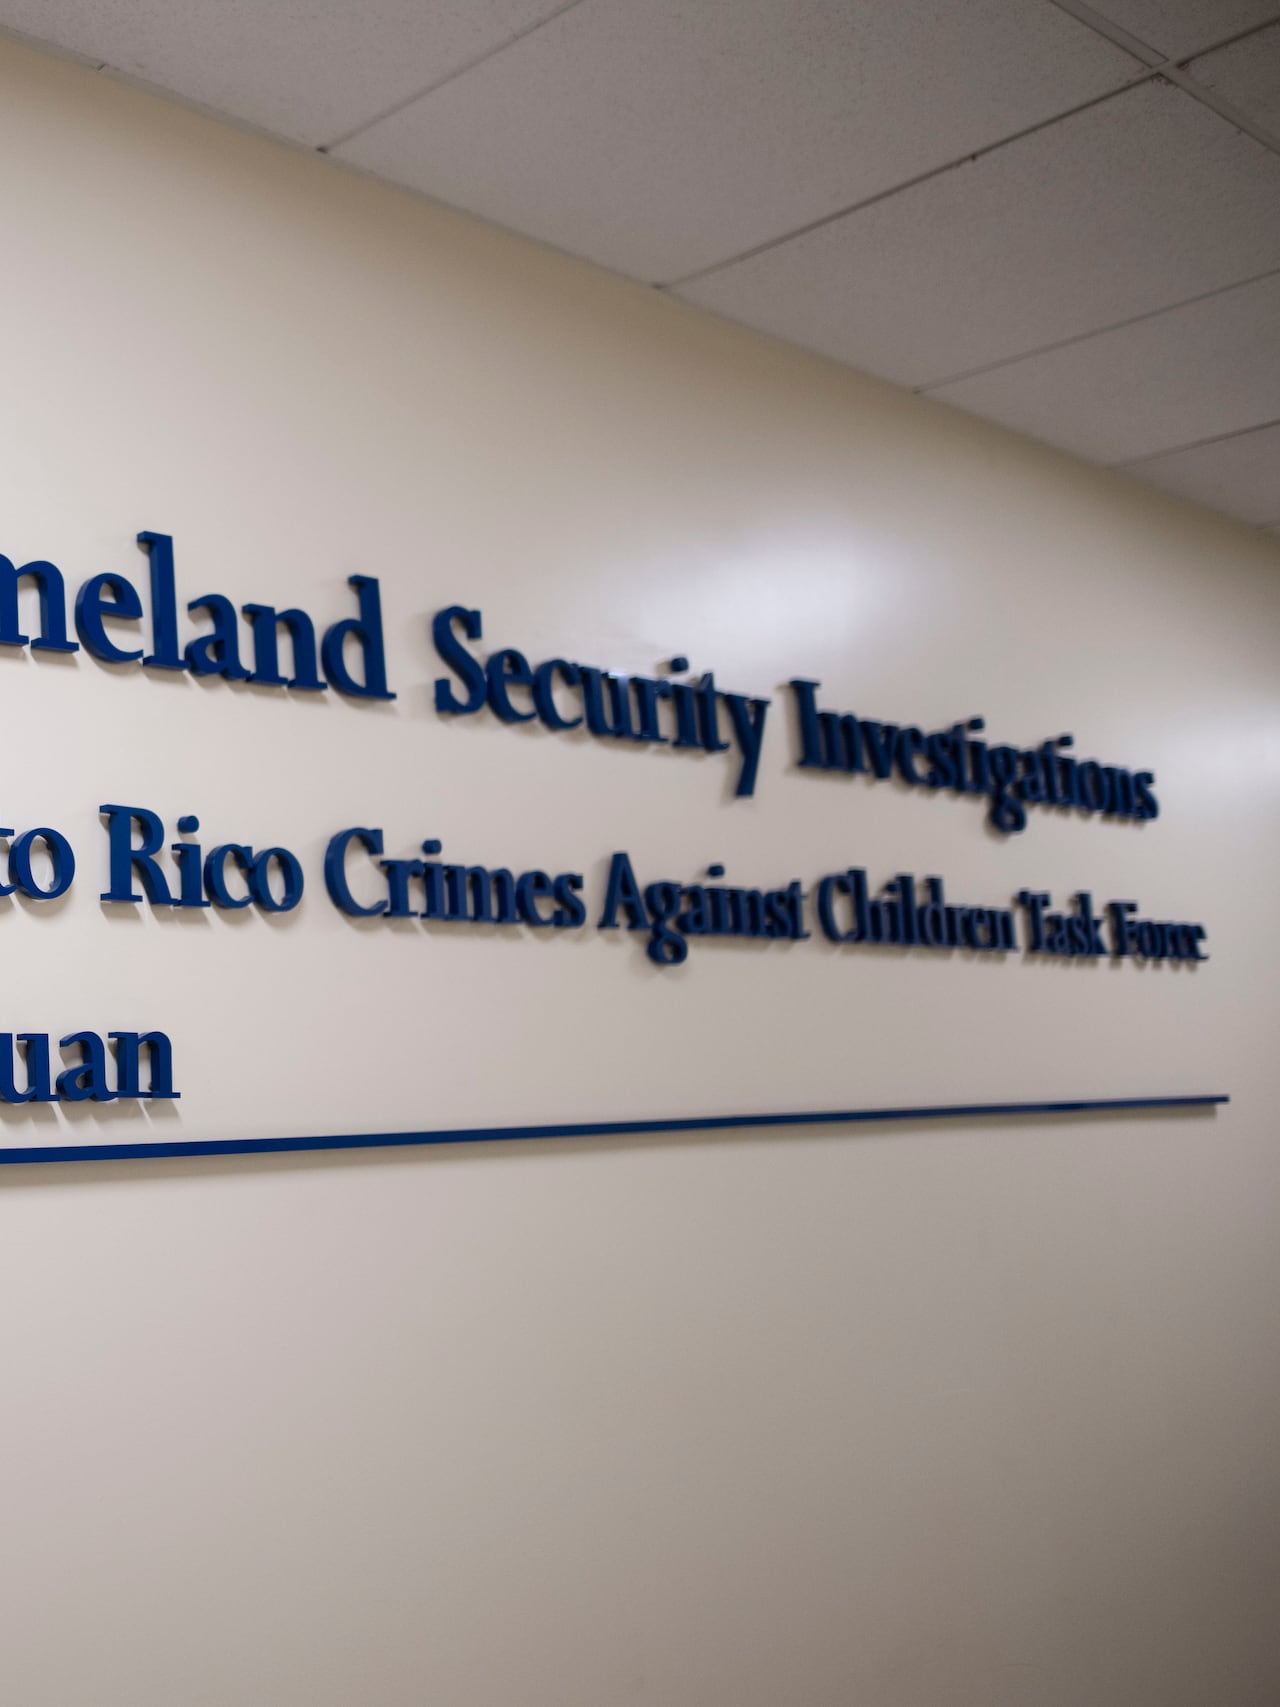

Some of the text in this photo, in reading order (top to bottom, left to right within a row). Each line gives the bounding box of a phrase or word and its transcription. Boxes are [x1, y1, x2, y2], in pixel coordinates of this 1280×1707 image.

[431, 605, 769, 796] Security
[789, 679, 1159, 832] Investigations
[99, 804, 304, 912] Rico
[323, 827, 586, 928] Crimes
[598, 852, 810, 964] Against
[818, 867, 1017, 951] Children
[1017, 890, 1108, 955] Task
